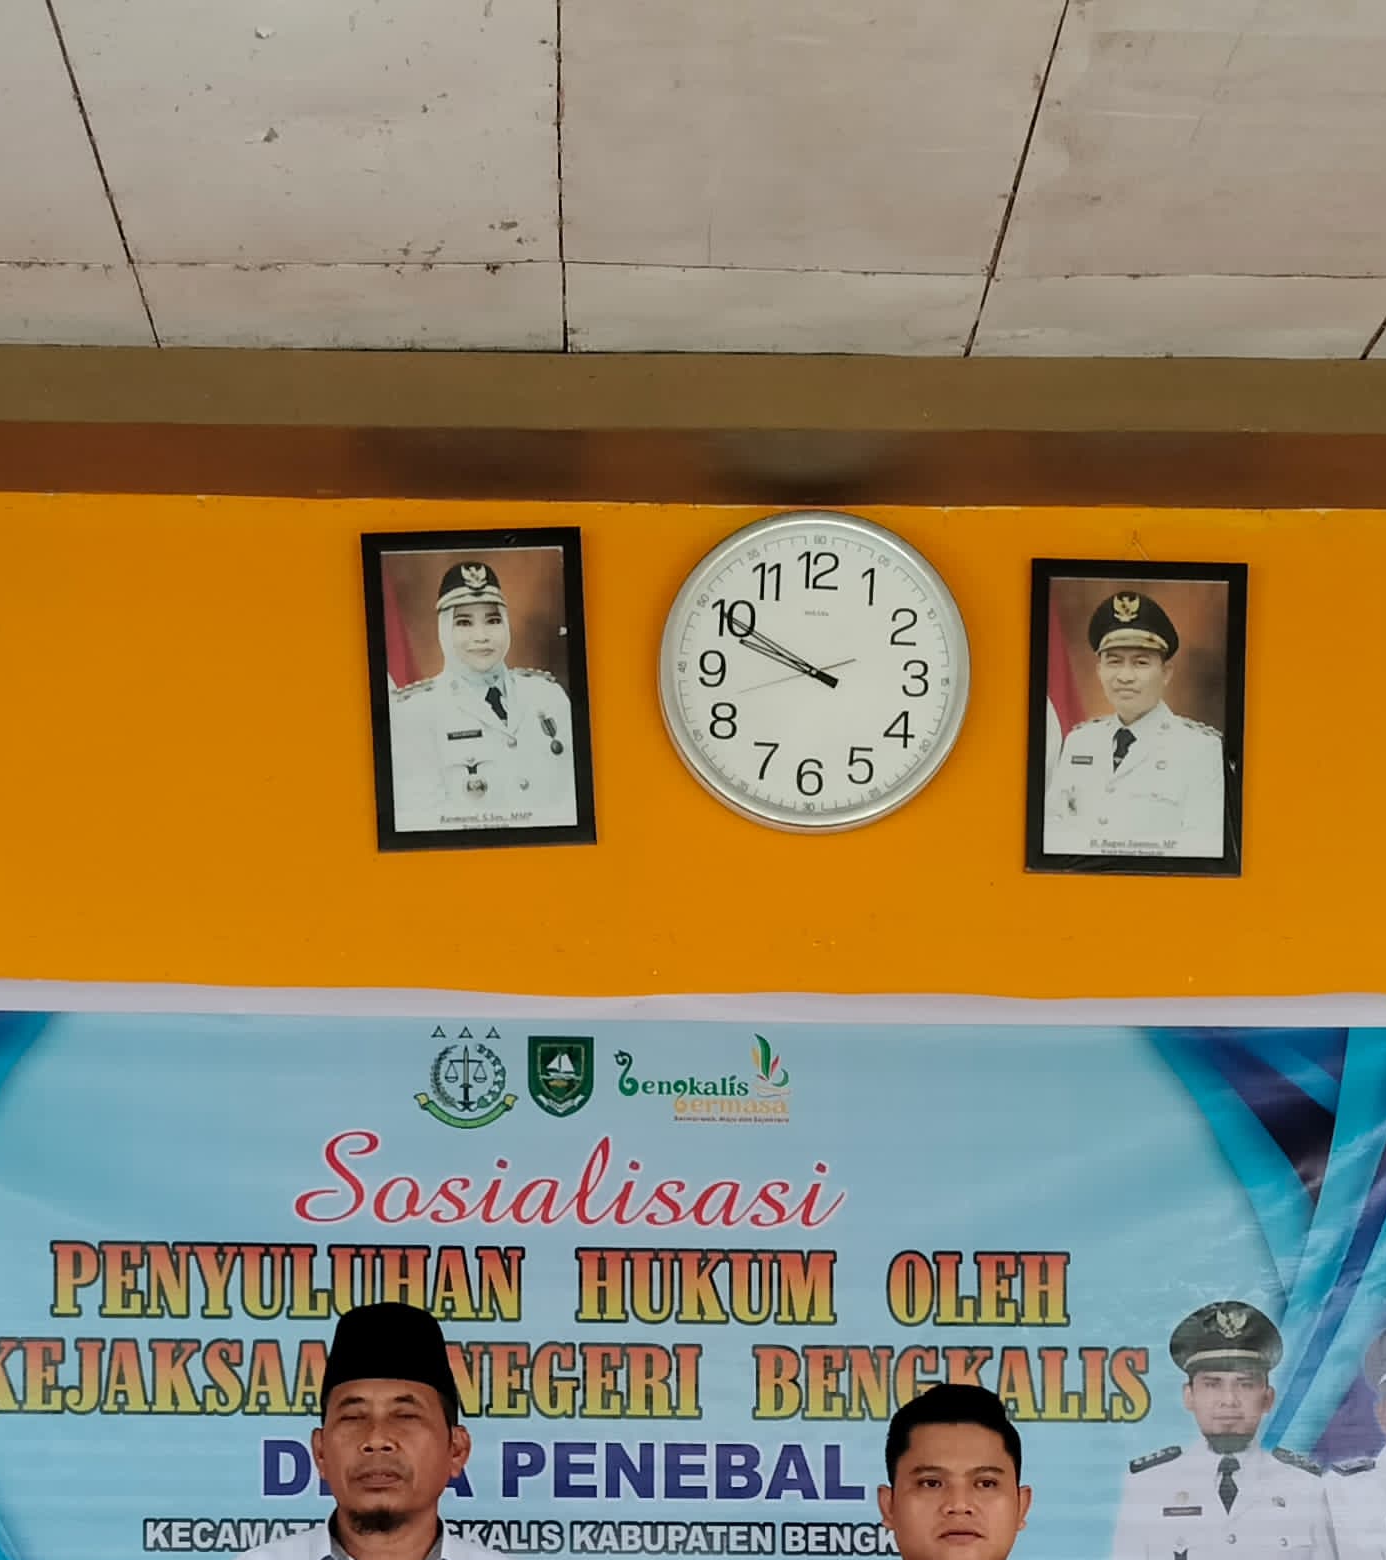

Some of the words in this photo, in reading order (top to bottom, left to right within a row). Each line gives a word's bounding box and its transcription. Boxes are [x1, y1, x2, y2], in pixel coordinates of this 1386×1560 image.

[752, 562, 781, 601] 11
[797, 551, 839, 590] 12
[861, 567, 875, 606] 1
[711, 599, 756, 637] 10
[890, 608, 917, 646] 2
[698, 650, 726, 688] 9
[902, 660, 929, 697] 3
[709, 702, 737, 740] 8
[883, 710, 915, 749] 4
[754, 741, 780, 780] 7
[796, 758, 823, 796] 6
[847, 746, 874, 784] 5
[294, 1130, 845, 1227] Sosialisasi
[50, 1240, 525, 1322] PENYULUHAN
[574, 1247, 838, 1326] HUKUM
[887, 1250, 1072, 1328] OLEH
[753, 1344, 1154, 1423] BENGKALIS
[502, 1441, 866, 1502] PENEBAL
[570, 1520, 775, 1555] KABUPATEN
